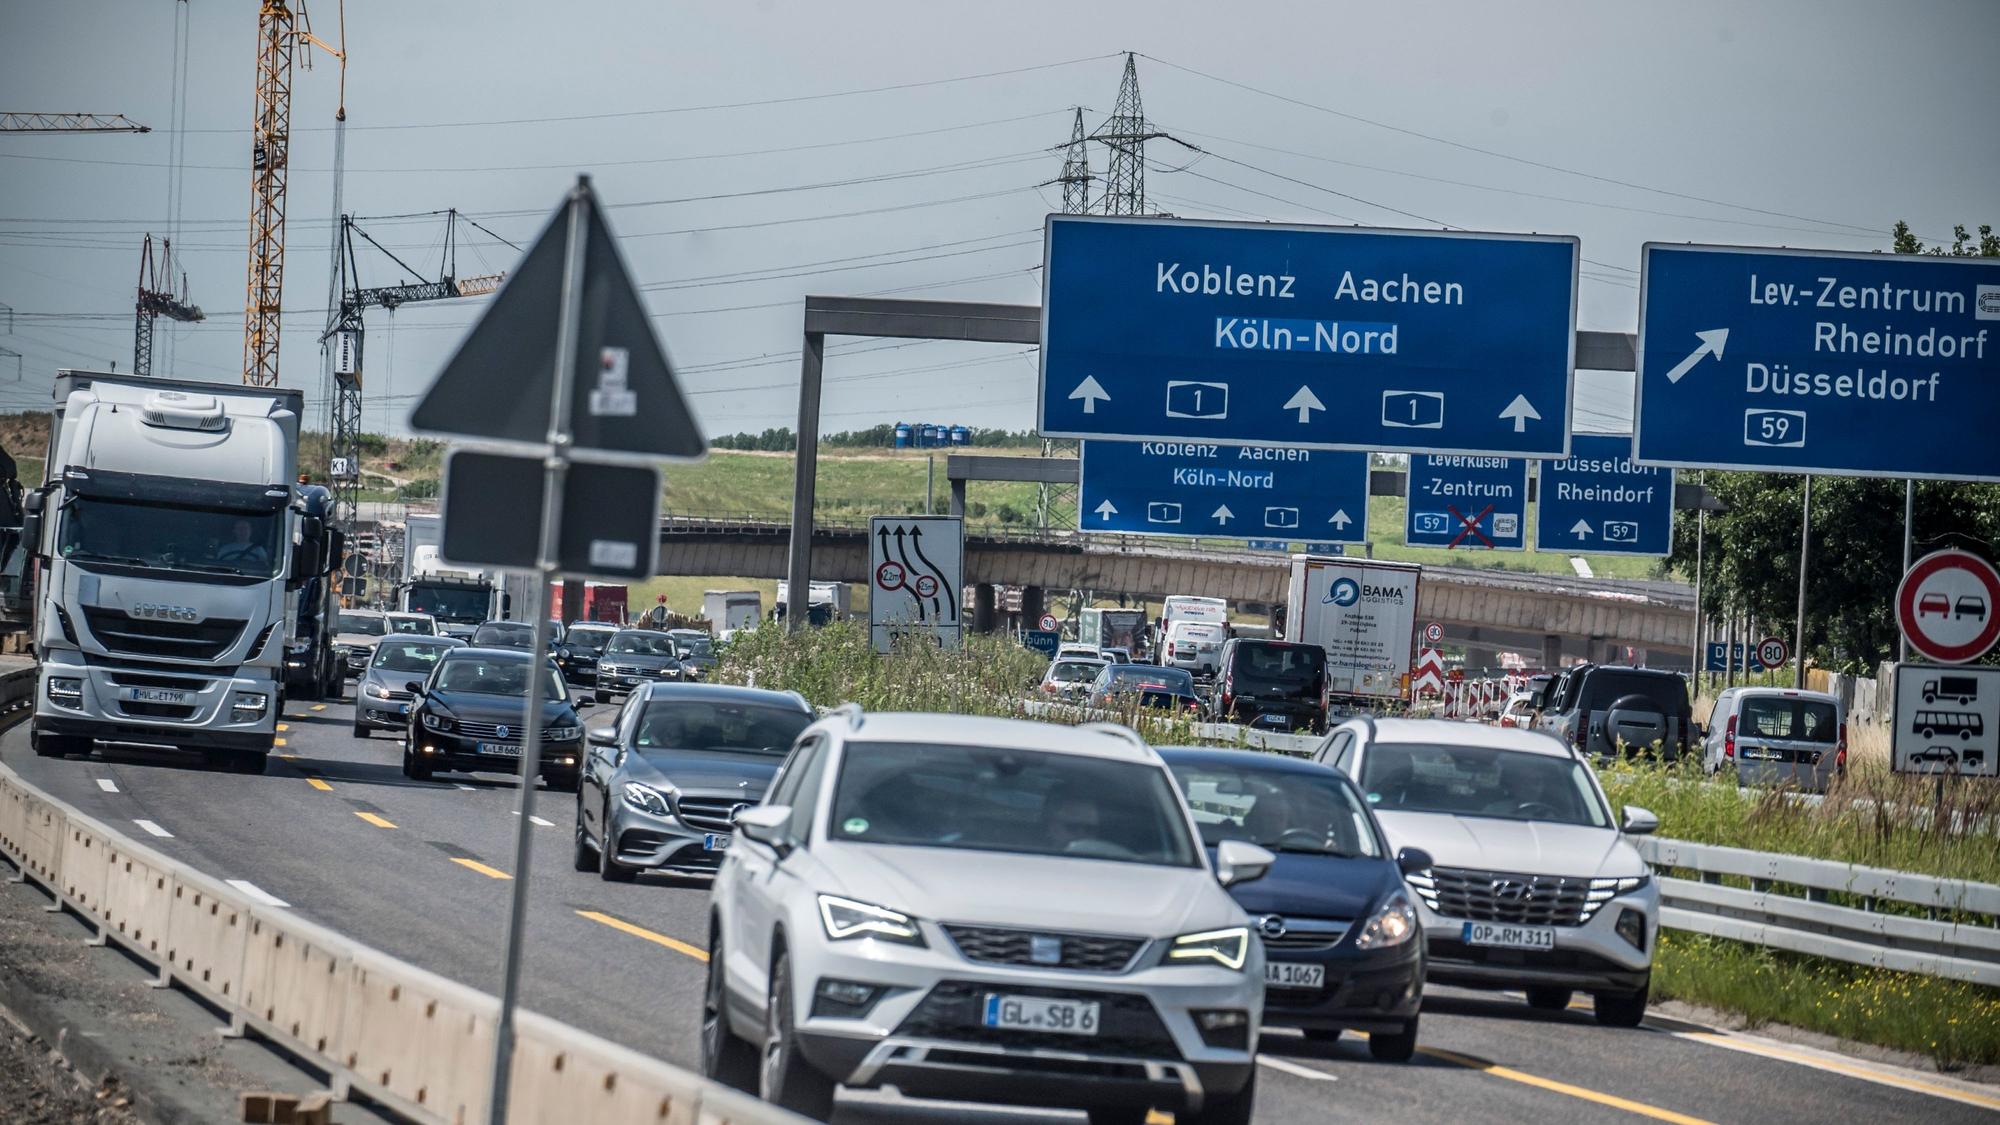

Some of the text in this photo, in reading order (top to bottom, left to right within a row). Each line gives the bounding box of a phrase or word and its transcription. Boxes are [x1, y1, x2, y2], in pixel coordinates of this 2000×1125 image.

[1156, 262, 1463, 305] Koblenz Aachen
[1750, 274, 1965, 314] Lev.-Zentrum
[1215, 317, 1398, 354] Köln-Nord
[1814, 321, 1988, 359] Rheindorf
[1746, 363, 1940, 401] Düsseldorf
[1761, 417, 1790, 440] 59
[1142, 442, 1310, 461] Koblenz Aachen
[1173, 467, 1274, 489] Köln-Nord
[1422, 477, 1513, 498] -Zentrum
[1557, 482, 1654, 503] Rheindorf
[1423, 516, 1440, 530] 59
[1612, 525, 1629, 538] 59
[1362, 585, 1404, 598] BAMA
[1362, 597, 1404, 606] LOGISTICS
[134, 602, 197, 620] IVECO
[1715, 646, 1758, 660] Dün
[1764, 646, 1782, 660] 80
[1473, 926, 1552, 945] OP RM 311
[1284, 966, 1322, 984] 1067
[1002, 1002, 1094, 1030] GL SB 6
